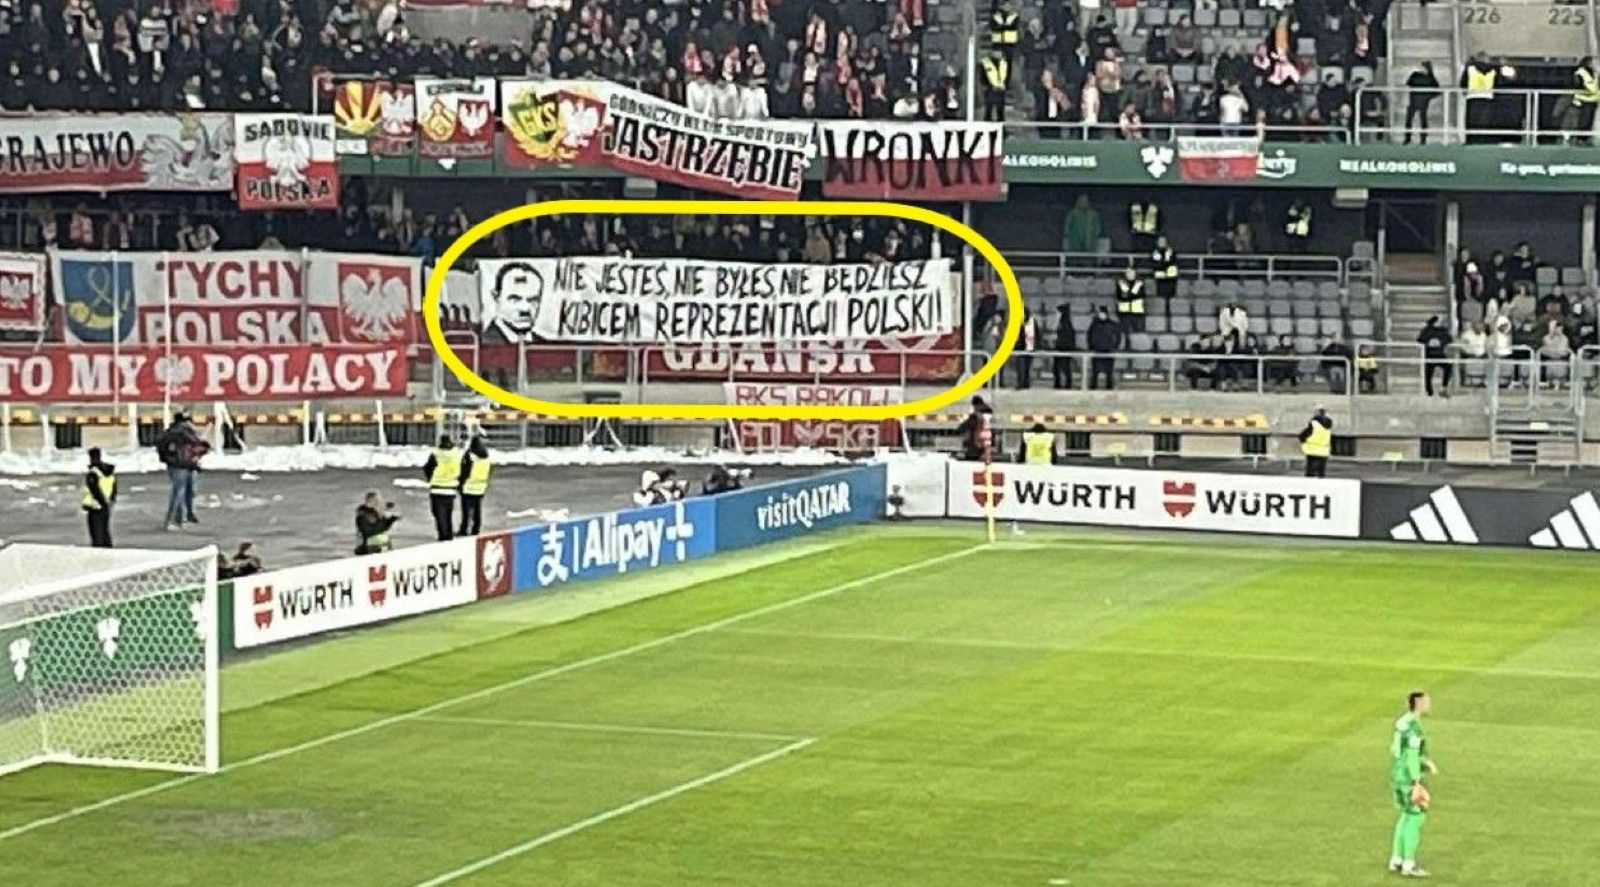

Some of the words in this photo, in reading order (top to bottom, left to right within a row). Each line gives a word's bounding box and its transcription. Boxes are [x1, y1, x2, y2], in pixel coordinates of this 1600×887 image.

[1464, 7, 1500, 24] 226
[1548, 8, 1585, 25] 225
[0, 130, 135, 173] RAJEWO
[603, 113, 805, 189] JASTRZĘBIE
[824, 129, 998, 190] WRONKI
[156, 261, 312, 299] TYCHY
[554, 259, 587, 291] NIE
[673, 265, 706, 296] NIE
[781, 268, 814, 297] NIE
[145, 310, 331, 345] POLSKA
[557, 299, 642, 340] KIBICEM
[655, 295, 838, 343] REPREZENTACJI
[847, 286, 944, 336] POLSKI!
[0, 355, 53, 397] TO
[67, 354, 148, 396] MY
[203, 350, 398, 396] POLACY
[756, 481, 851, 530] visitQATAR
[1014, 480, 1137, 510] WÜRTH
[1205, 490, 1331, 520] WÜRTH
[279, 578, 354, 619] WÜRTH
[392, 559, 463, 597] WÜRTH
